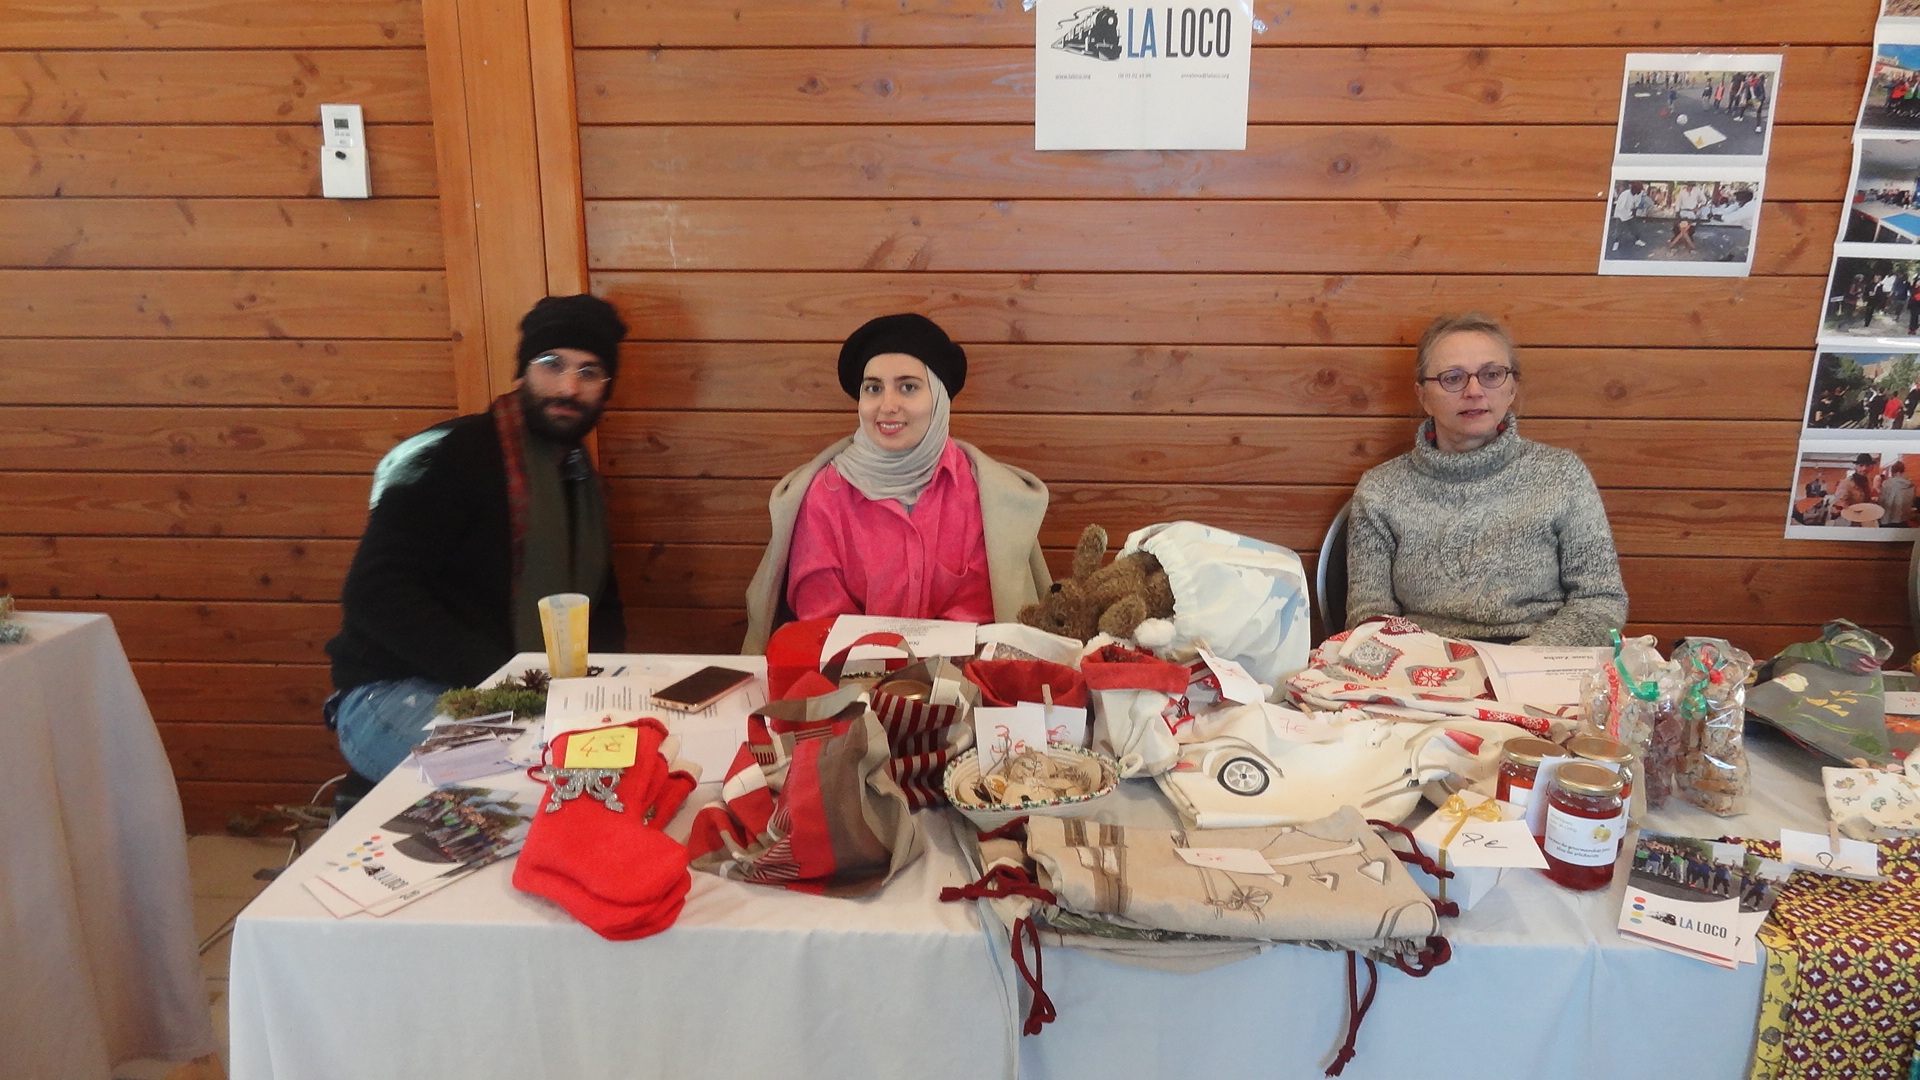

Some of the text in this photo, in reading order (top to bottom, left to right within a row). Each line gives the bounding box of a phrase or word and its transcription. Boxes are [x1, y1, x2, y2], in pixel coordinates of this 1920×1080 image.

[1127, 8, 1232, 58] LA LOCO
[1680, 917, 1727, 938] LA LOCO
